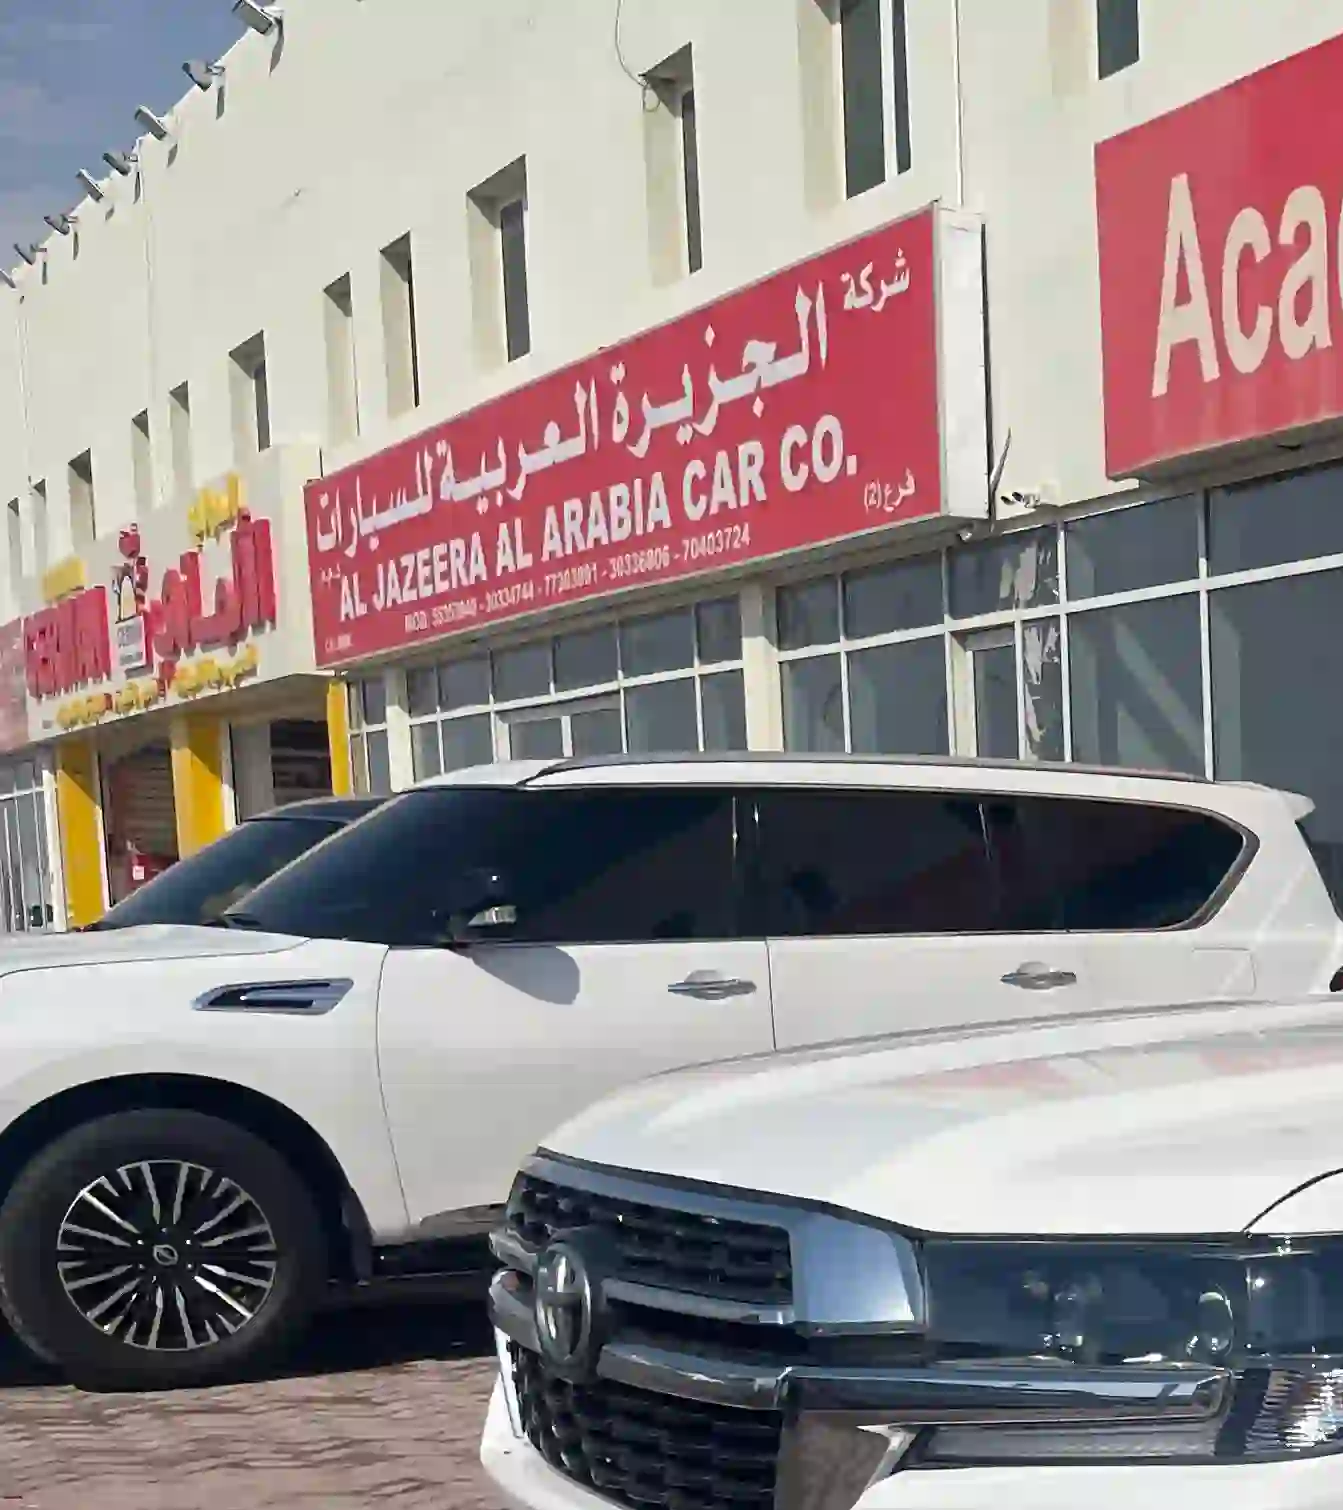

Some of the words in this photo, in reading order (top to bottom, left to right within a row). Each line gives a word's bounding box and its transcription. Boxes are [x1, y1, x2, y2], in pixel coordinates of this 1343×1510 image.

[840, 247, 911, 312] شركة
[609, 279, 828, 459] الجزيرة
[316, 445, 433, 558] للسيارات
[437, 376, 600, 515] العربية
[882, 468, 916, 512] فرع
[339, 571, 368, 622] AL
[373, 531, 487, 612] JAZEERA
[496, 517, 533, 577] AL
[540, 471, 672, 562] ARABIA
[682, 440, 768, 522] CAR
[780, 413, 858, 493] CO.
[681, 521, 752, 563] 70403724
